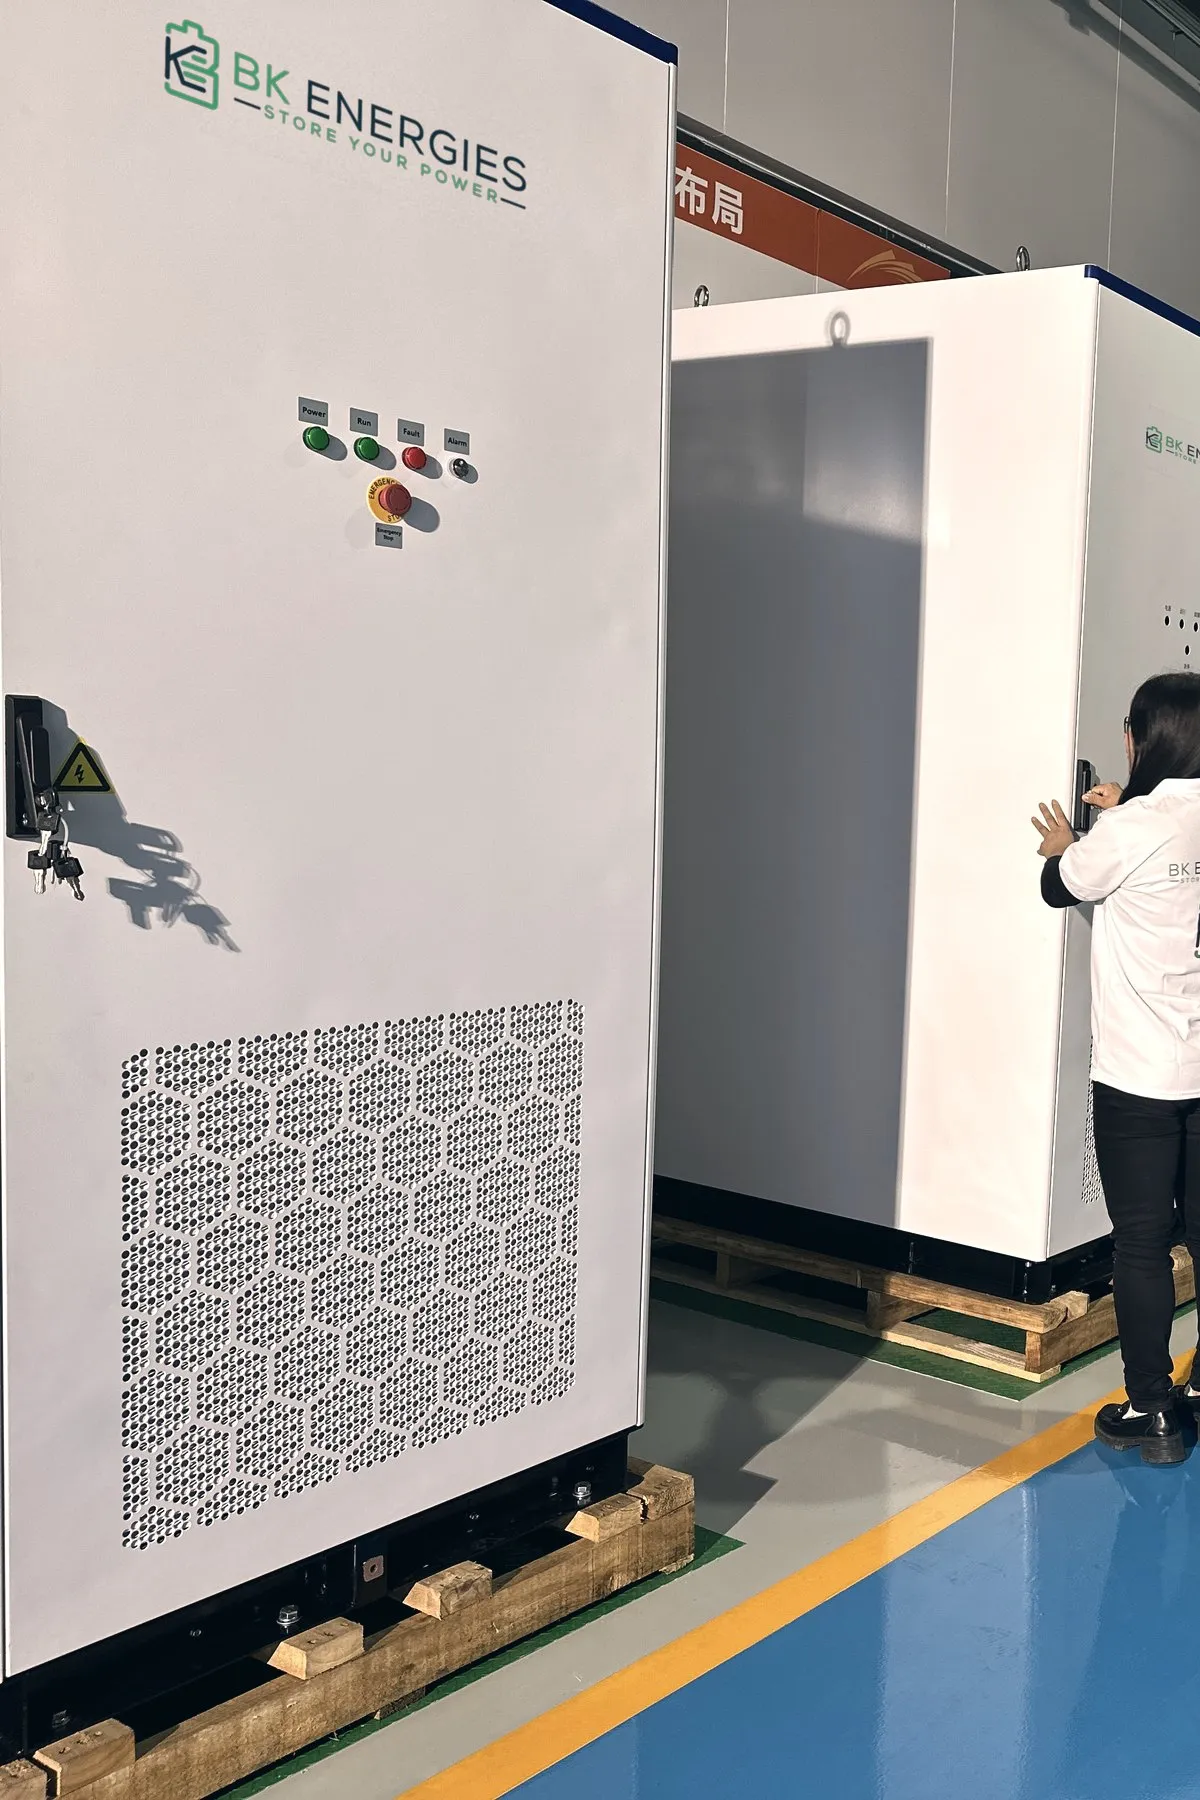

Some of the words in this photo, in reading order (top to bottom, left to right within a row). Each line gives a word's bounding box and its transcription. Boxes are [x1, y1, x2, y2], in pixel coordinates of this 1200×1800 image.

[233, 51, 290, 105] BK
[307, 79, 527, 192] ENERGIES
[264, 104, 337, 144] STORE
[349, 136, 408, 170] YOUR
[420, 163, 498, 204] POWER
[675, 167, 744, 235] 布局
[302, 406, 326, 419] Power
[357, 417, 372, 428] Run
[403, 428, 421, 439] Fault
[448, 437, 468, 448] Alarm
[1165, 436, 1183, 453] BK
[1174, 451, 1197, 465] STORE
[368, 477, 397, 500] EMERGENC
[1168, 862, 1190, 877] BK
